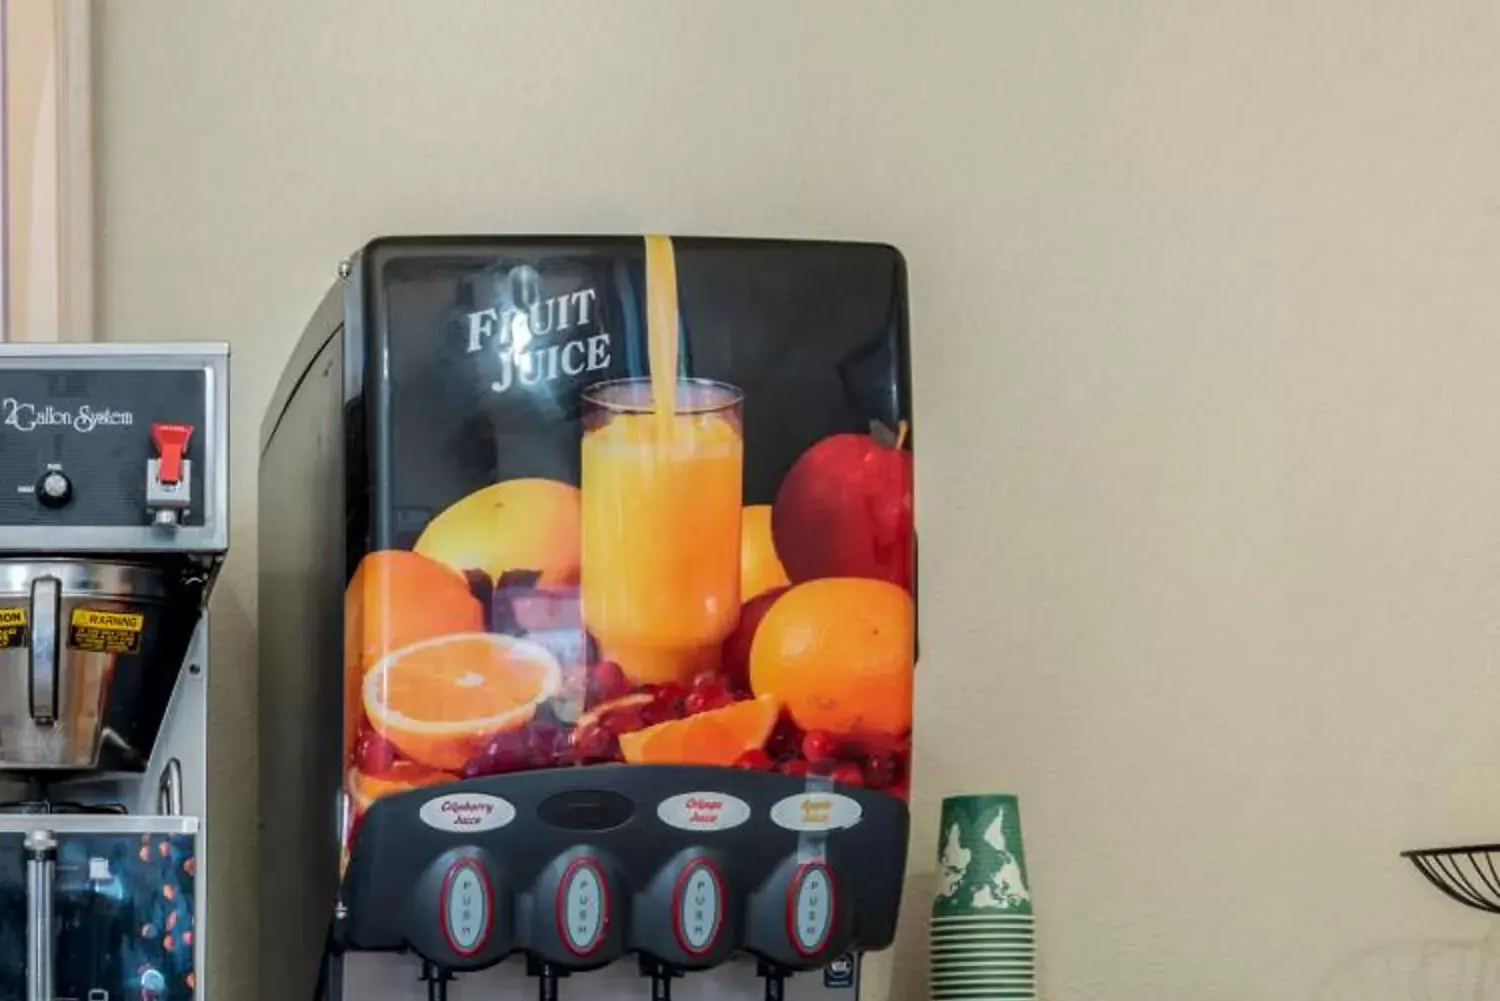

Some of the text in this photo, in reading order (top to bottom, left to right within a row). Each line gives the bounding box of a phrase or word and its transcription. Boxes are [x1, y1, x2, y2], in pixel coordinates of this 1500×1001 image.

[467, 288, 596, 352] FRUIT
[491, 333, 611, 392] JUICE
[74, 405, 133, 433] System
[89, 614, 137, 628] WARNING
[578, 881, 589, 935] PUSH
